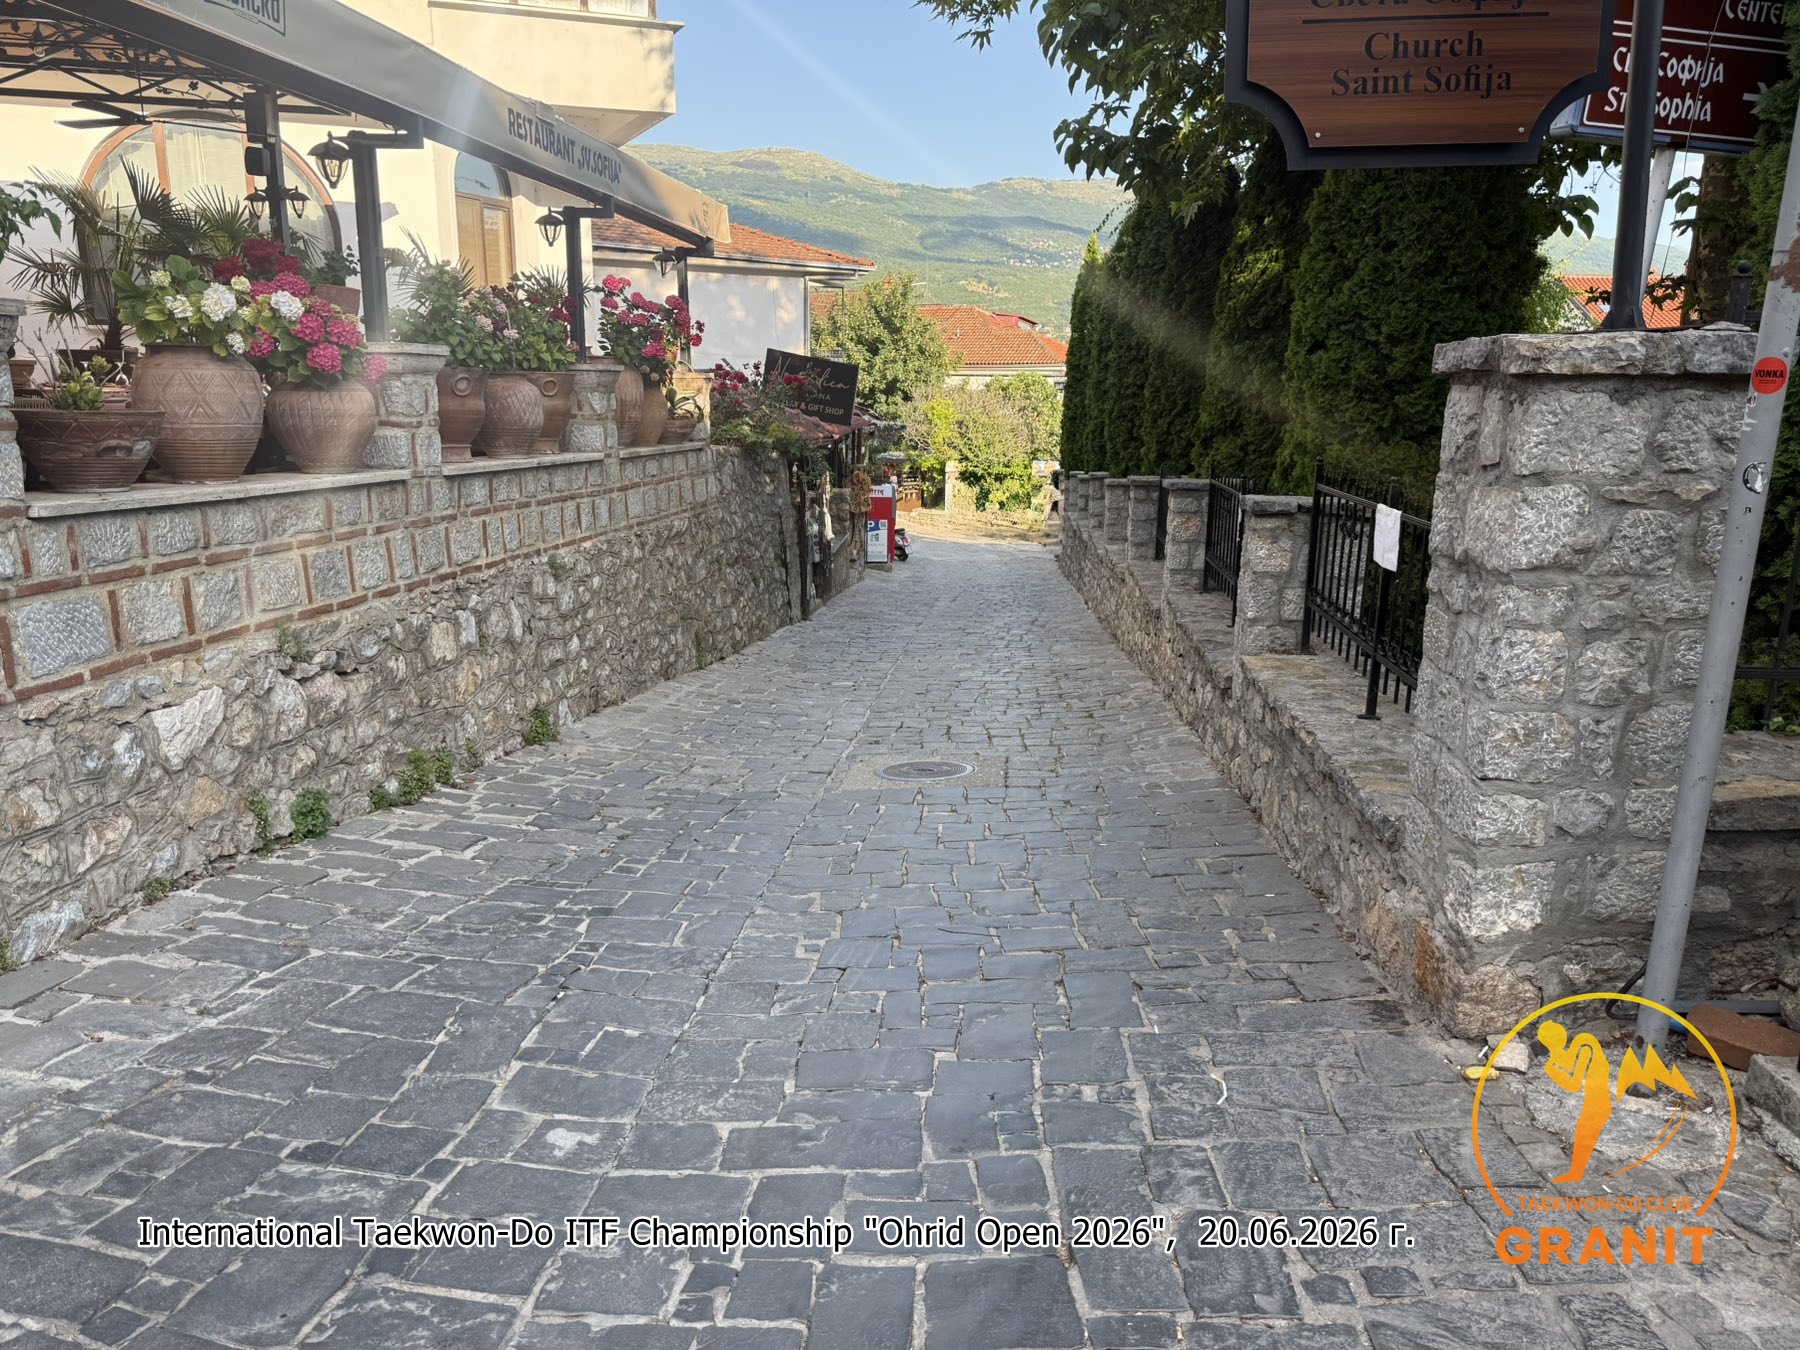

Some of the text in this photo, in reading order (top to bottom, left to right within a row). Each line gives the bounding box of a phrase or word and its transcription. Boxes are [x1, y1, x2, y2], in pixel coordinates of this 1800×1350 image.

[1364, 30, 1483, 60] Church
[1331, 63, 1512, 99] Saint Sofija
[1655, 92, 1711, 125] ophia
[508, 107, 575, 164] RESTAURANT
[1754, 369, 1784, 379] VONKA
[808, 403, 824, 412] GIFT
[824, 406, 845, 416] SHOP
